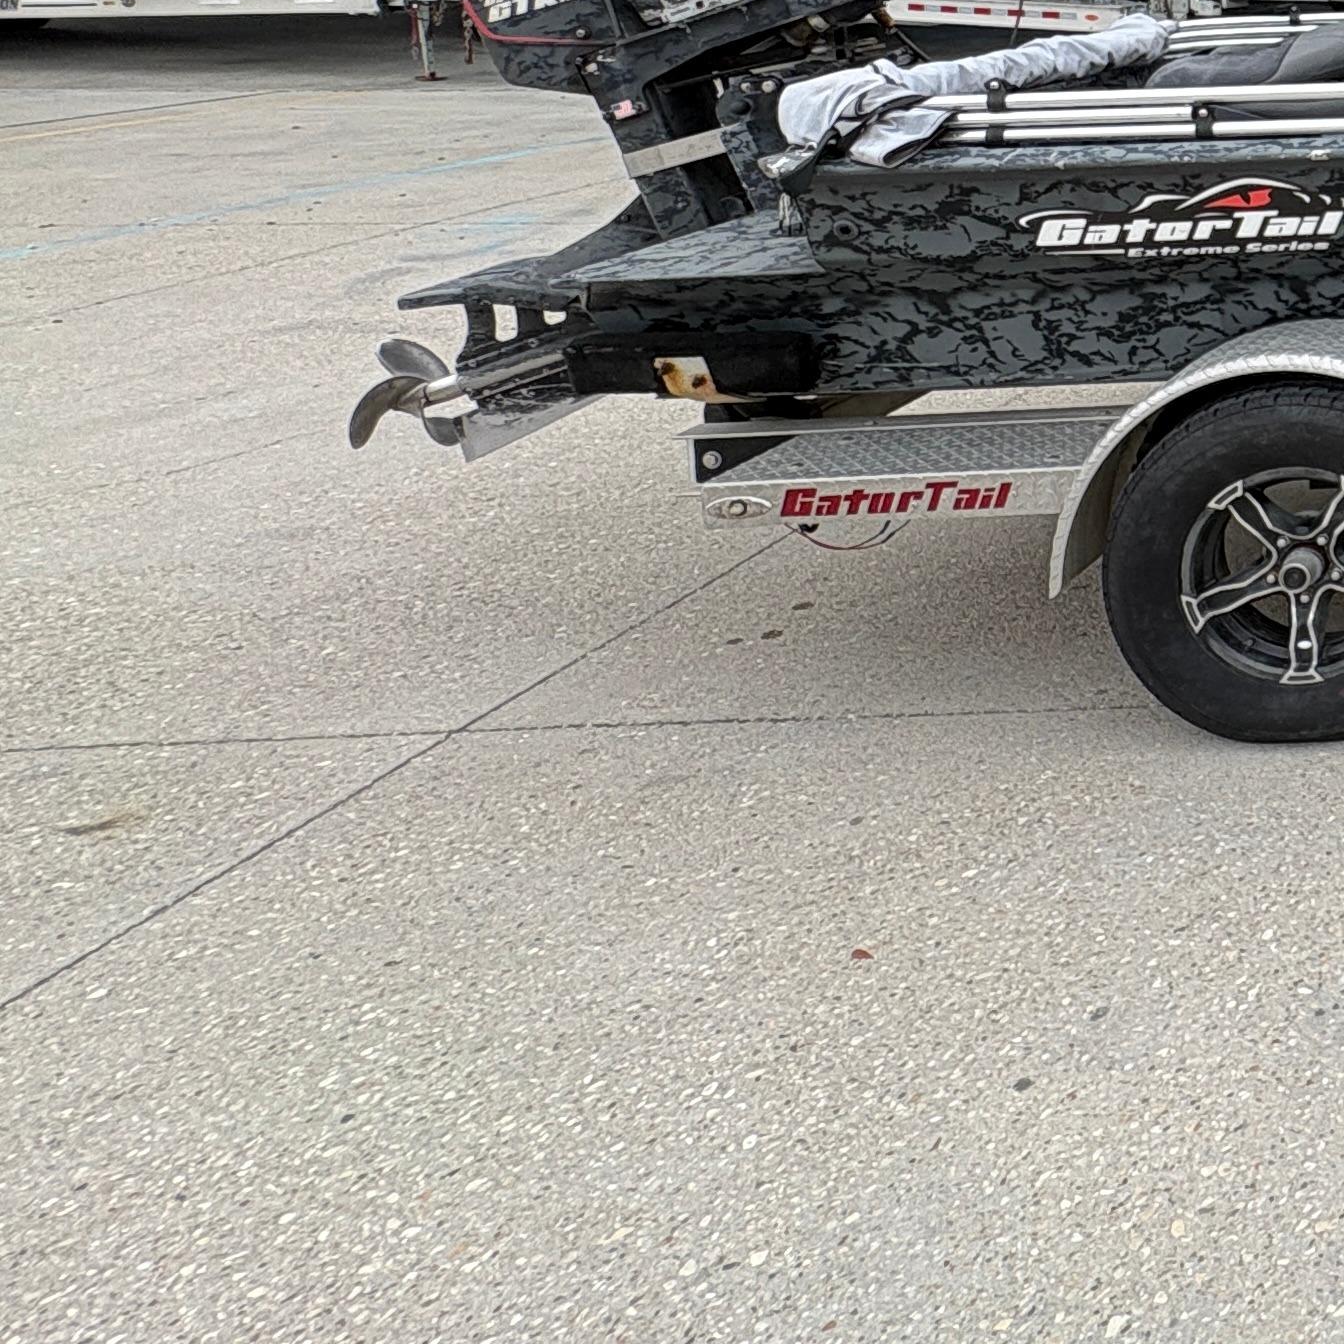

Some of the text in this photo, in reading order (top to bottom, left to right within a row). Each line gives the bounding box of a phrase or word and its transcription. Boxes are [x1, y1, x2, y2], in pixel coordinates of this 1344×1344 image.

[1036, 210, 1344, 247] GatorTail
[1127, 241, 1330, 258] Extreme Series
